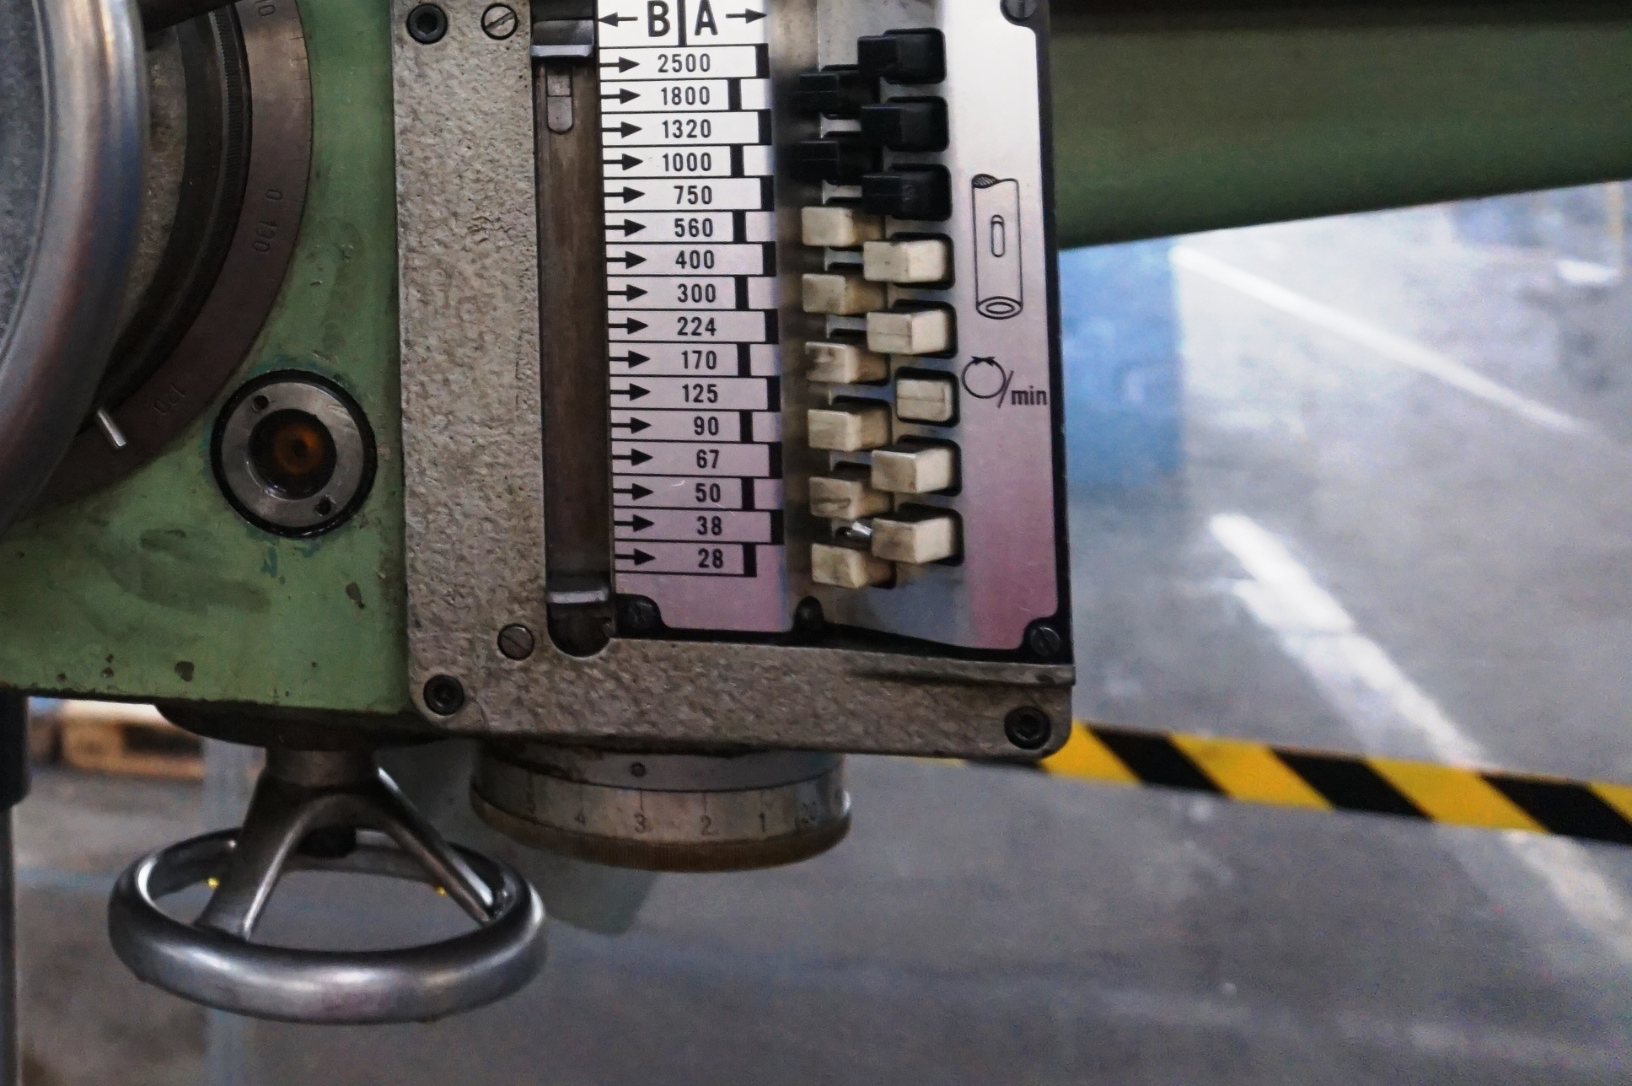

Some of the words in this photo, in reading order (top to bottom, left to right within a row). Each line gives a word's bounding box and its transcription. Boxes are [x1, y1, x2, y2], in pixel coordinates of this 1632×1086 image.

[647, 0, 671, 38] B
[657, 53, 711, 74] 2500
[660, 85, 711, 106] 1800
[661, 118, 712, 139] 1320
[662, 152, 712, 172] 1000
[673, 185, 713, 205] 750
[674, 217, 714, 238] 560
[675, 249, 715, 270] 400
[677, 283, 717, 304] 300
[676, 316, 717, 337] 224
[681, 350, 717, 370] 170
[681, 383, 718, 404] 125
[693, 416, 719, 436] 90
[696, 449, 720, 469] 67
[695, 483, 721, 503] 50
[697, 515, 722, 536] 38
[697, 548, 724, 569] 28
[634, 814, 647, 833] 3
[700, 814, 716, 836] 2
